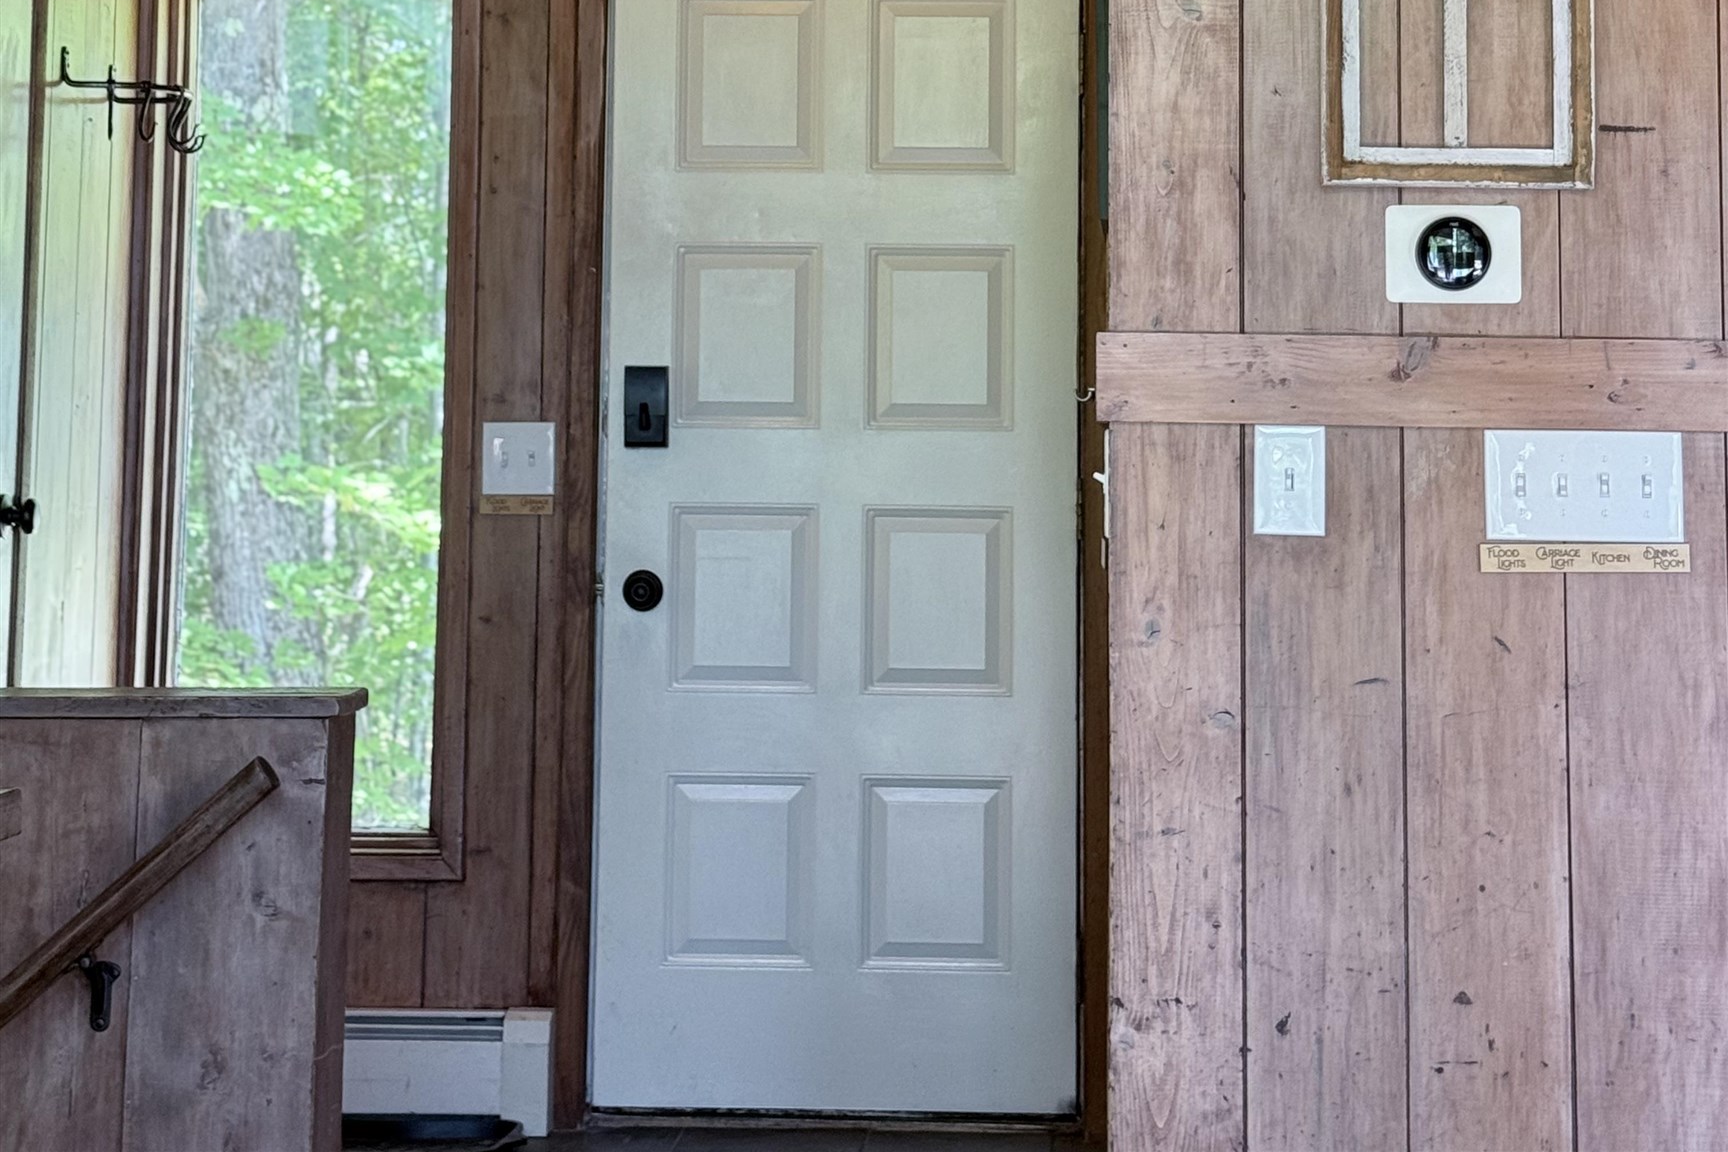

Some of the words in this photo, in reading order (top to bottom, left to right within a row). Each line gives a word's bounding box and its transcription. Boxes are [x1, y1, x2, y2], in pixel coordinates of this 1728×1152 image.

[1487, 546, 1520, 558] FLOOD
[1536, 546, 1581, 560] CARRIAGE
[1592, 551, 1631, 565] KITCHEN
[1643, 546, 1679, 560] DINING
[1497, 556, 1526, 571] LIGHTS
[1550, 557, 1575, 570] LIGHT
[1653, 557, 1685, 570] ROOM
